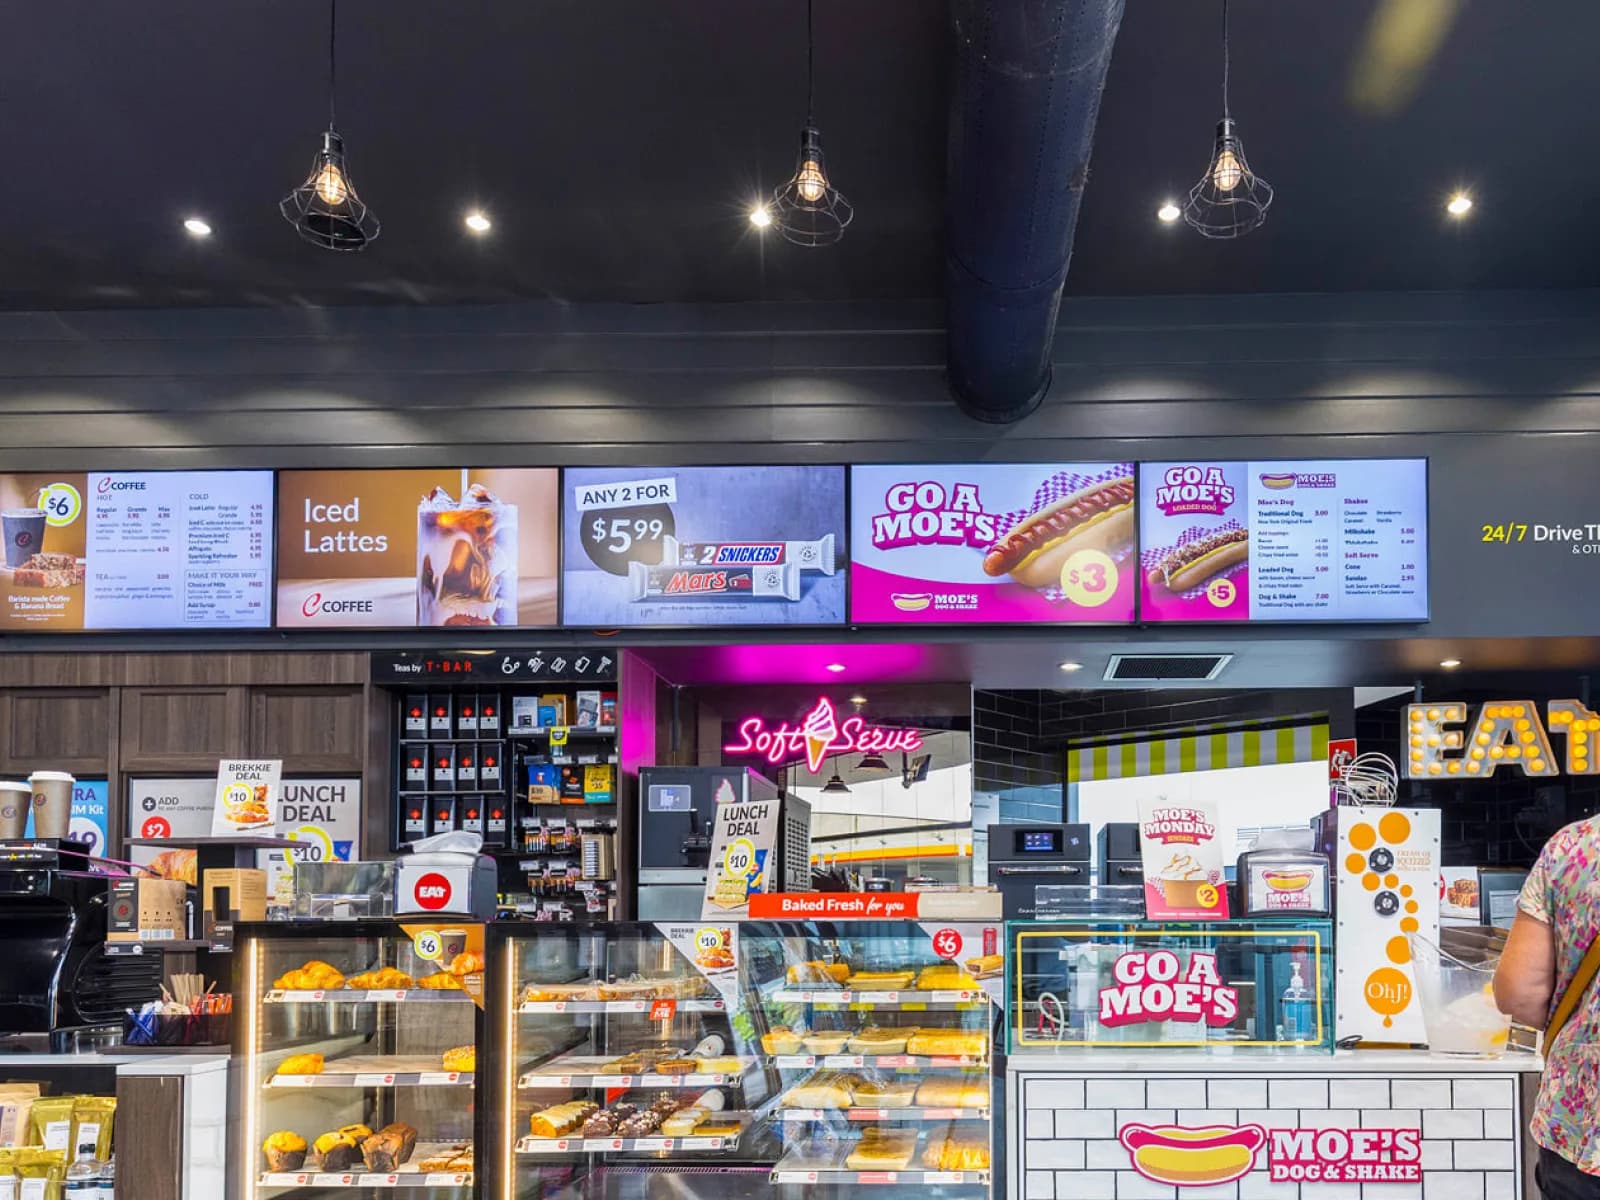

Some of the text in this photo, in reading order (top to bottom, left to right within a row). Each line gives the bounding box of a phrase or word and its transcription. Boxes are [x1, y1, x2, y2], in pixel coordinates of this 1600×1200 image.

[1166, 468, 1225, 485] GO A
[111, 482, 146, 490] COFFEE
[583, 484, 670, 504] ANY 2 FOR
[888, 482, 981, 512] GO A
[1158, 485, 1234, 504] MOE'S
[48, 497, 69, 516] $6
[304, 498, 359, 522] Iced
[873, 512, 995, 543] MOE'S
[1482, 522, 1600, 544] 24/7 Drive T
[304, 530, 388, 552] Lattes
[701, 546, 780, 564] 2 SNICKERS
[1572, 545, 1600, 554] & OT
[664, 570, 727, 594] Mars
[1070, 563, 1107, 592] $3
[322, 601, 373, 613] COFFEE
[934, 594, 978, 604] MOE'S
[393, 664, 411, 672] Teas
[411, 664, 422, 673] by
[725, 719, 805, 762] Soft
[1408, 700, 1600, 779] EAT
[229, 764, 272, 772] BREKKIE
[236, 772, 262, 780] DEAL
[75, 788, 97, 800] RA
[159, 797, 180, 806] ADD
[230, 792, 247, 802] $10
[278, 786, 345, 803] UNCH
[72, 804, 86, 814] IM
[283, 806, 336, 822] DEAL
[724, 805, 768, 821] LUNCH
[1153, 808, 1206, 823] MOE'S
[727, 822, 760, 837] DEAL
[1145, 821, 1215, 836] MONDAY
[294, 847, 322, 862] $10
[730, 855, 748, 868] $10
[419, 886, 446, 898] EAT
[782, 896, 905, 917] Baked Fresh for you
[421, 940, 436, 953] $6
[701, 936, 717, 947] $10
[938, 936, 957, 953] $6
[1114, 951, 1219, 984] GO A
[1100, 983, 1237, 1020] MOE'S
[1271, 1130, 1420, 1162] MOE'S
[1273, 1164, 1419, 1180] DOG & SHAKE
